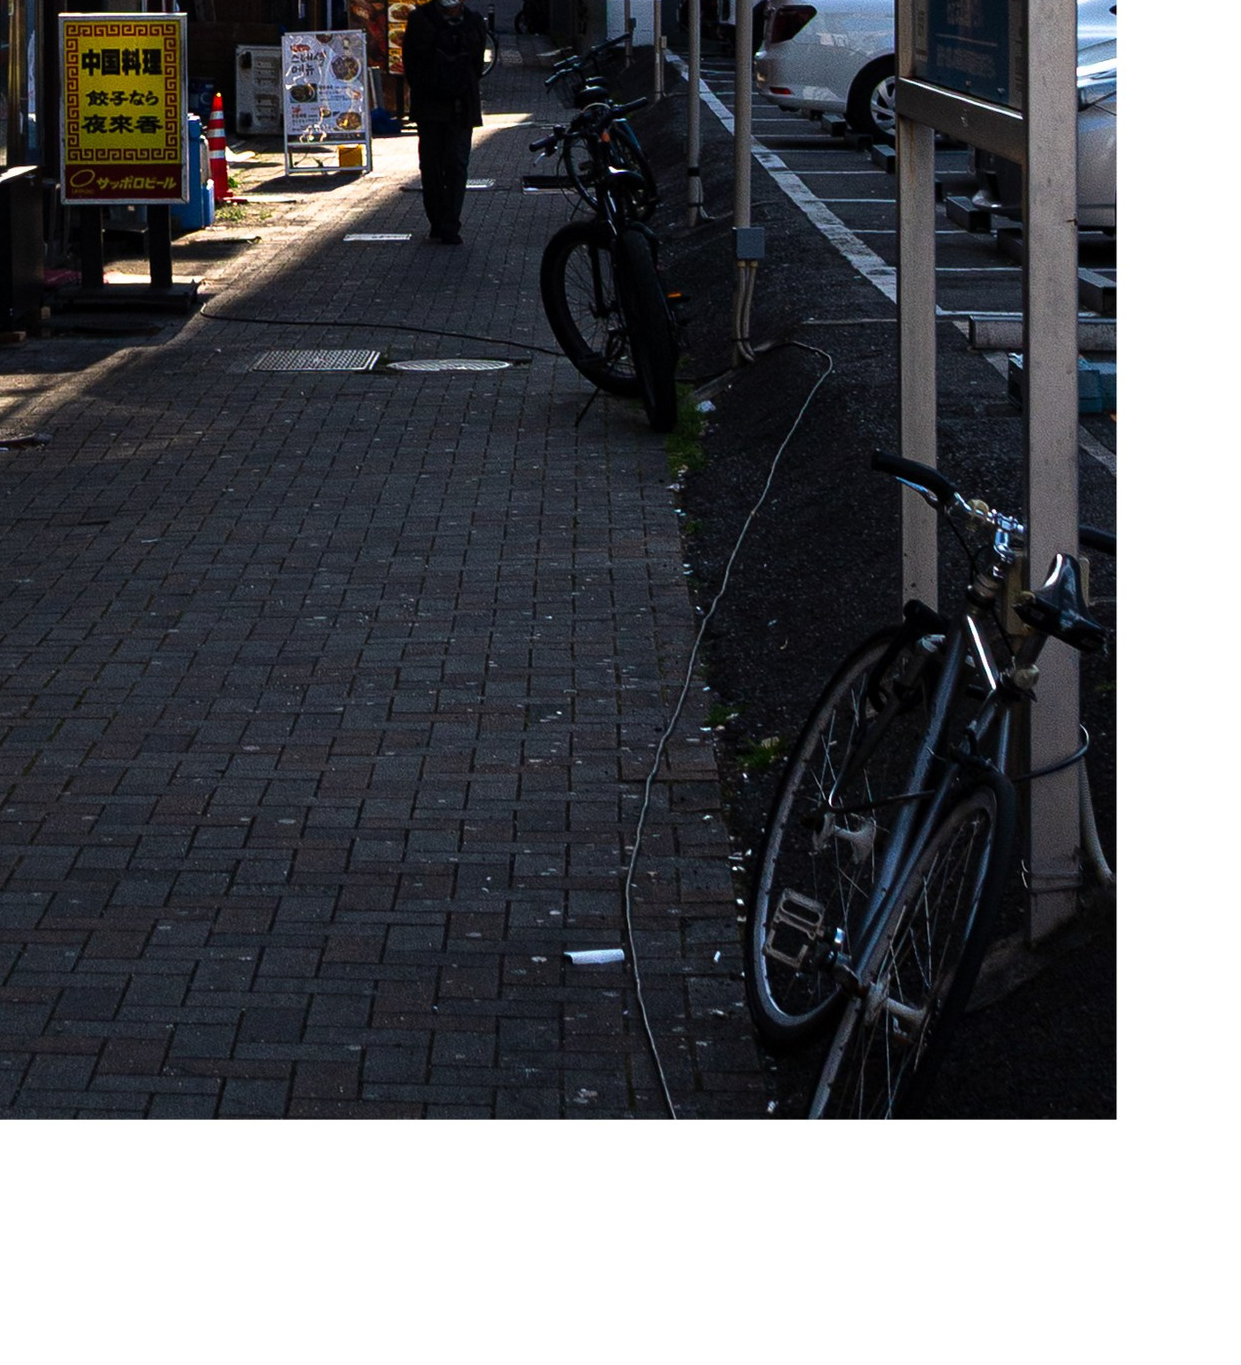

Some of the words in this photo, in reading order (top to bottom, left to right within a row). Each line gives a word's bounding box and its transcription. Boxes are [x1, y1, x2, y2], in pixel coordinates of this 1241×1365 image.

[81, 48, 163, 76] 中国料理
[86, 89, 159, 106] 餃子なら
[95, 174, 177, 190] サッポロビール
